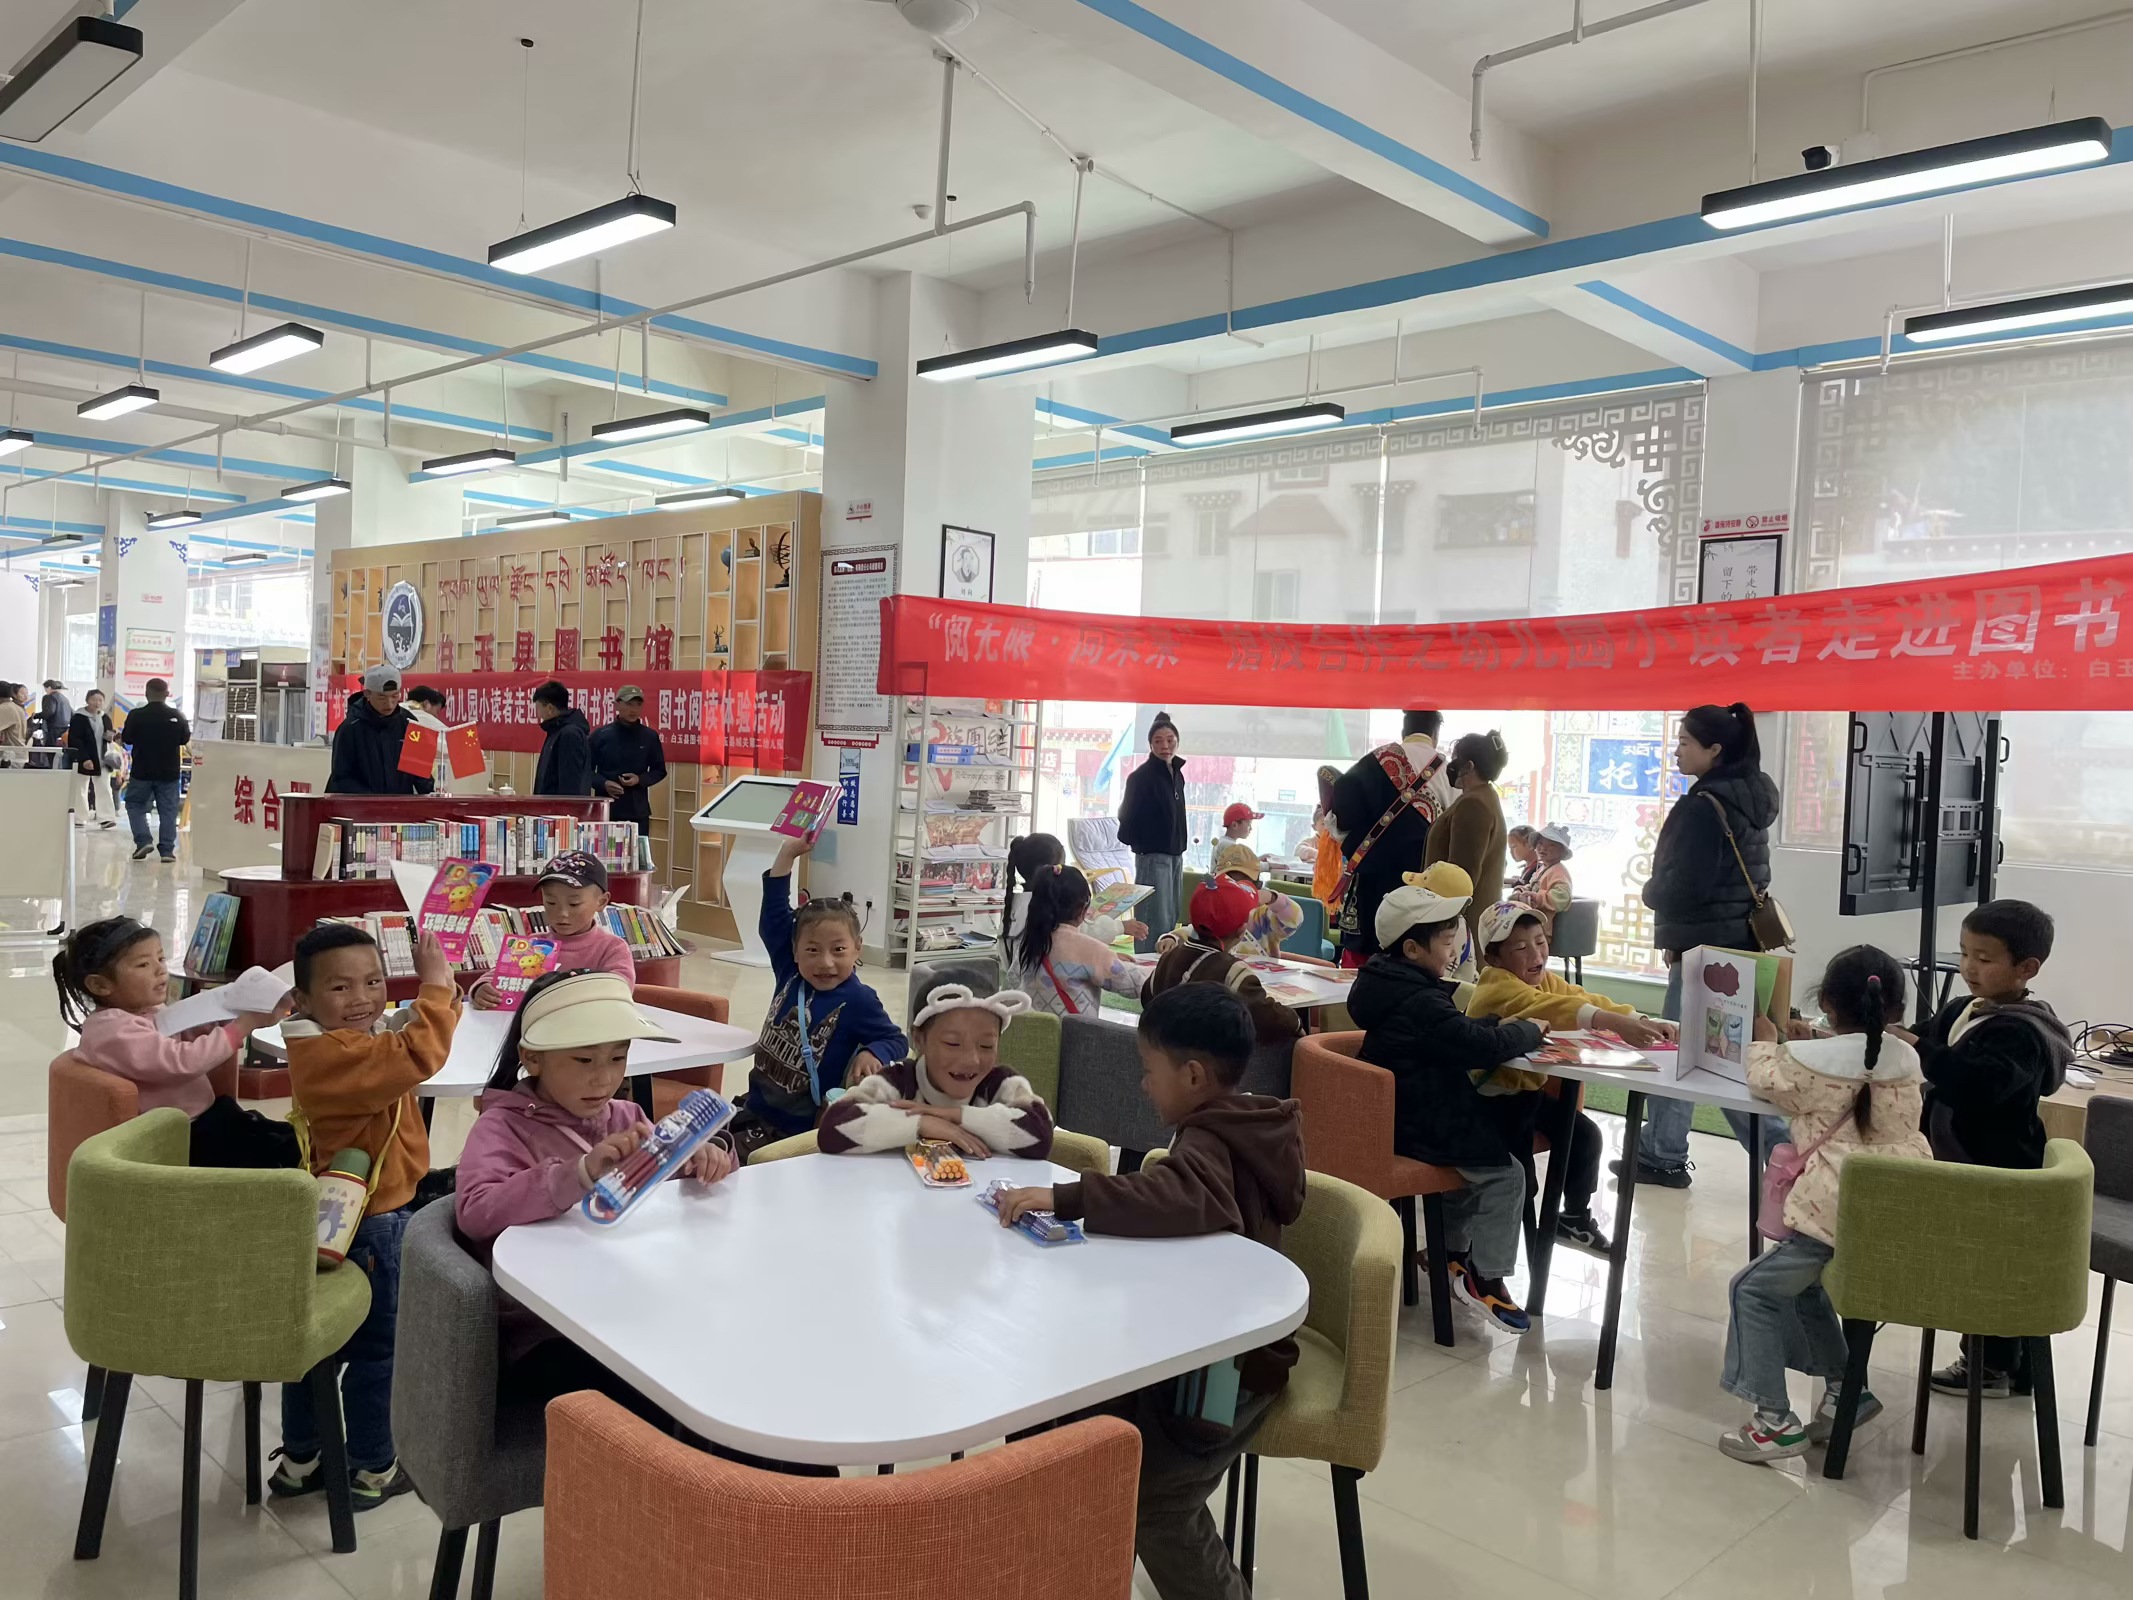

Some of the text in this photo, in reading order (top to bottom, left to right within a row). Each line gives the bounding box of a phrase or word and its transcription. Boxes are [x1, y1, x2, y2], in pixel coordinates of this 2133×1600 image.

[437, 623, 675, 673] 白玉县图书馆
